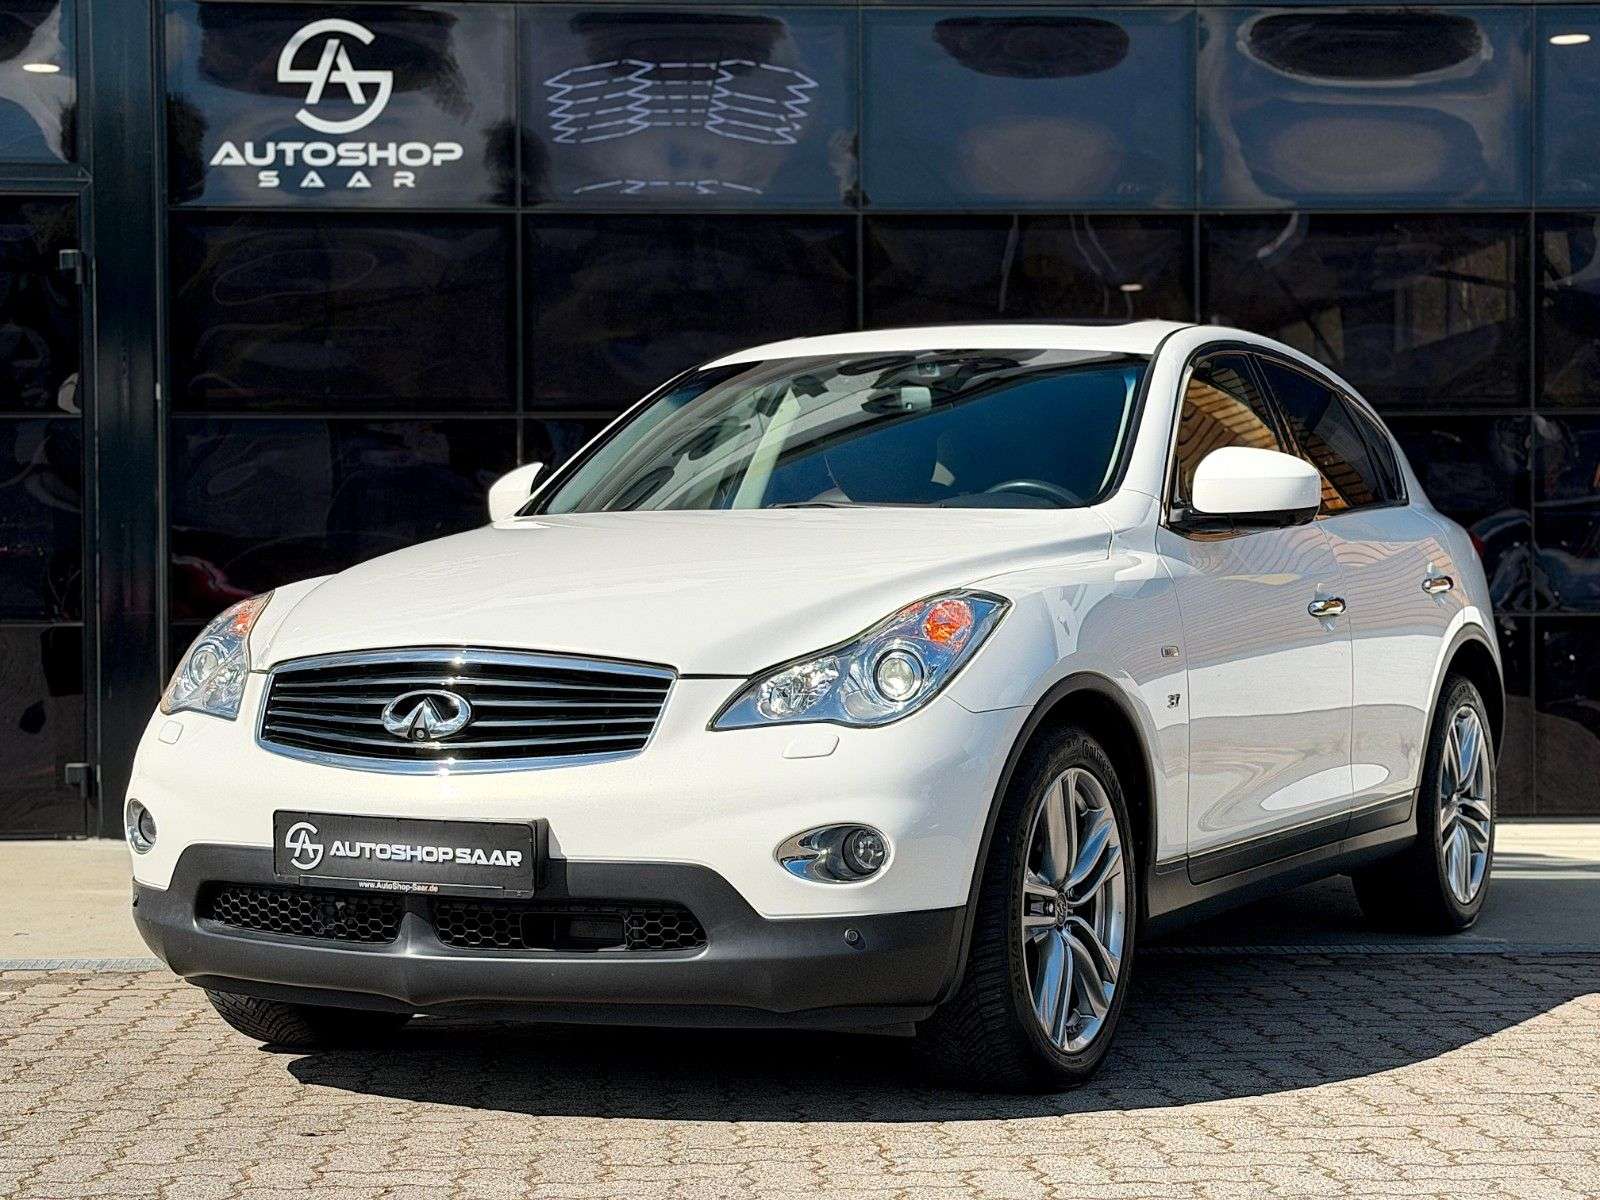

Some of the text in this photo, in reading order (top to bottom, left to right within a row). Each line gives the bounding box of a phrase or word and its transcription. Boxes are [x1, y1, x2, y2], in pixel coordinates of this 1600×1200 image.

[209, 141, 463, 166] AUTOSHOP
[258, 171, 415, 188] SAAR
[358, 881, 439, 893] www.AutoShop-Saar.de
